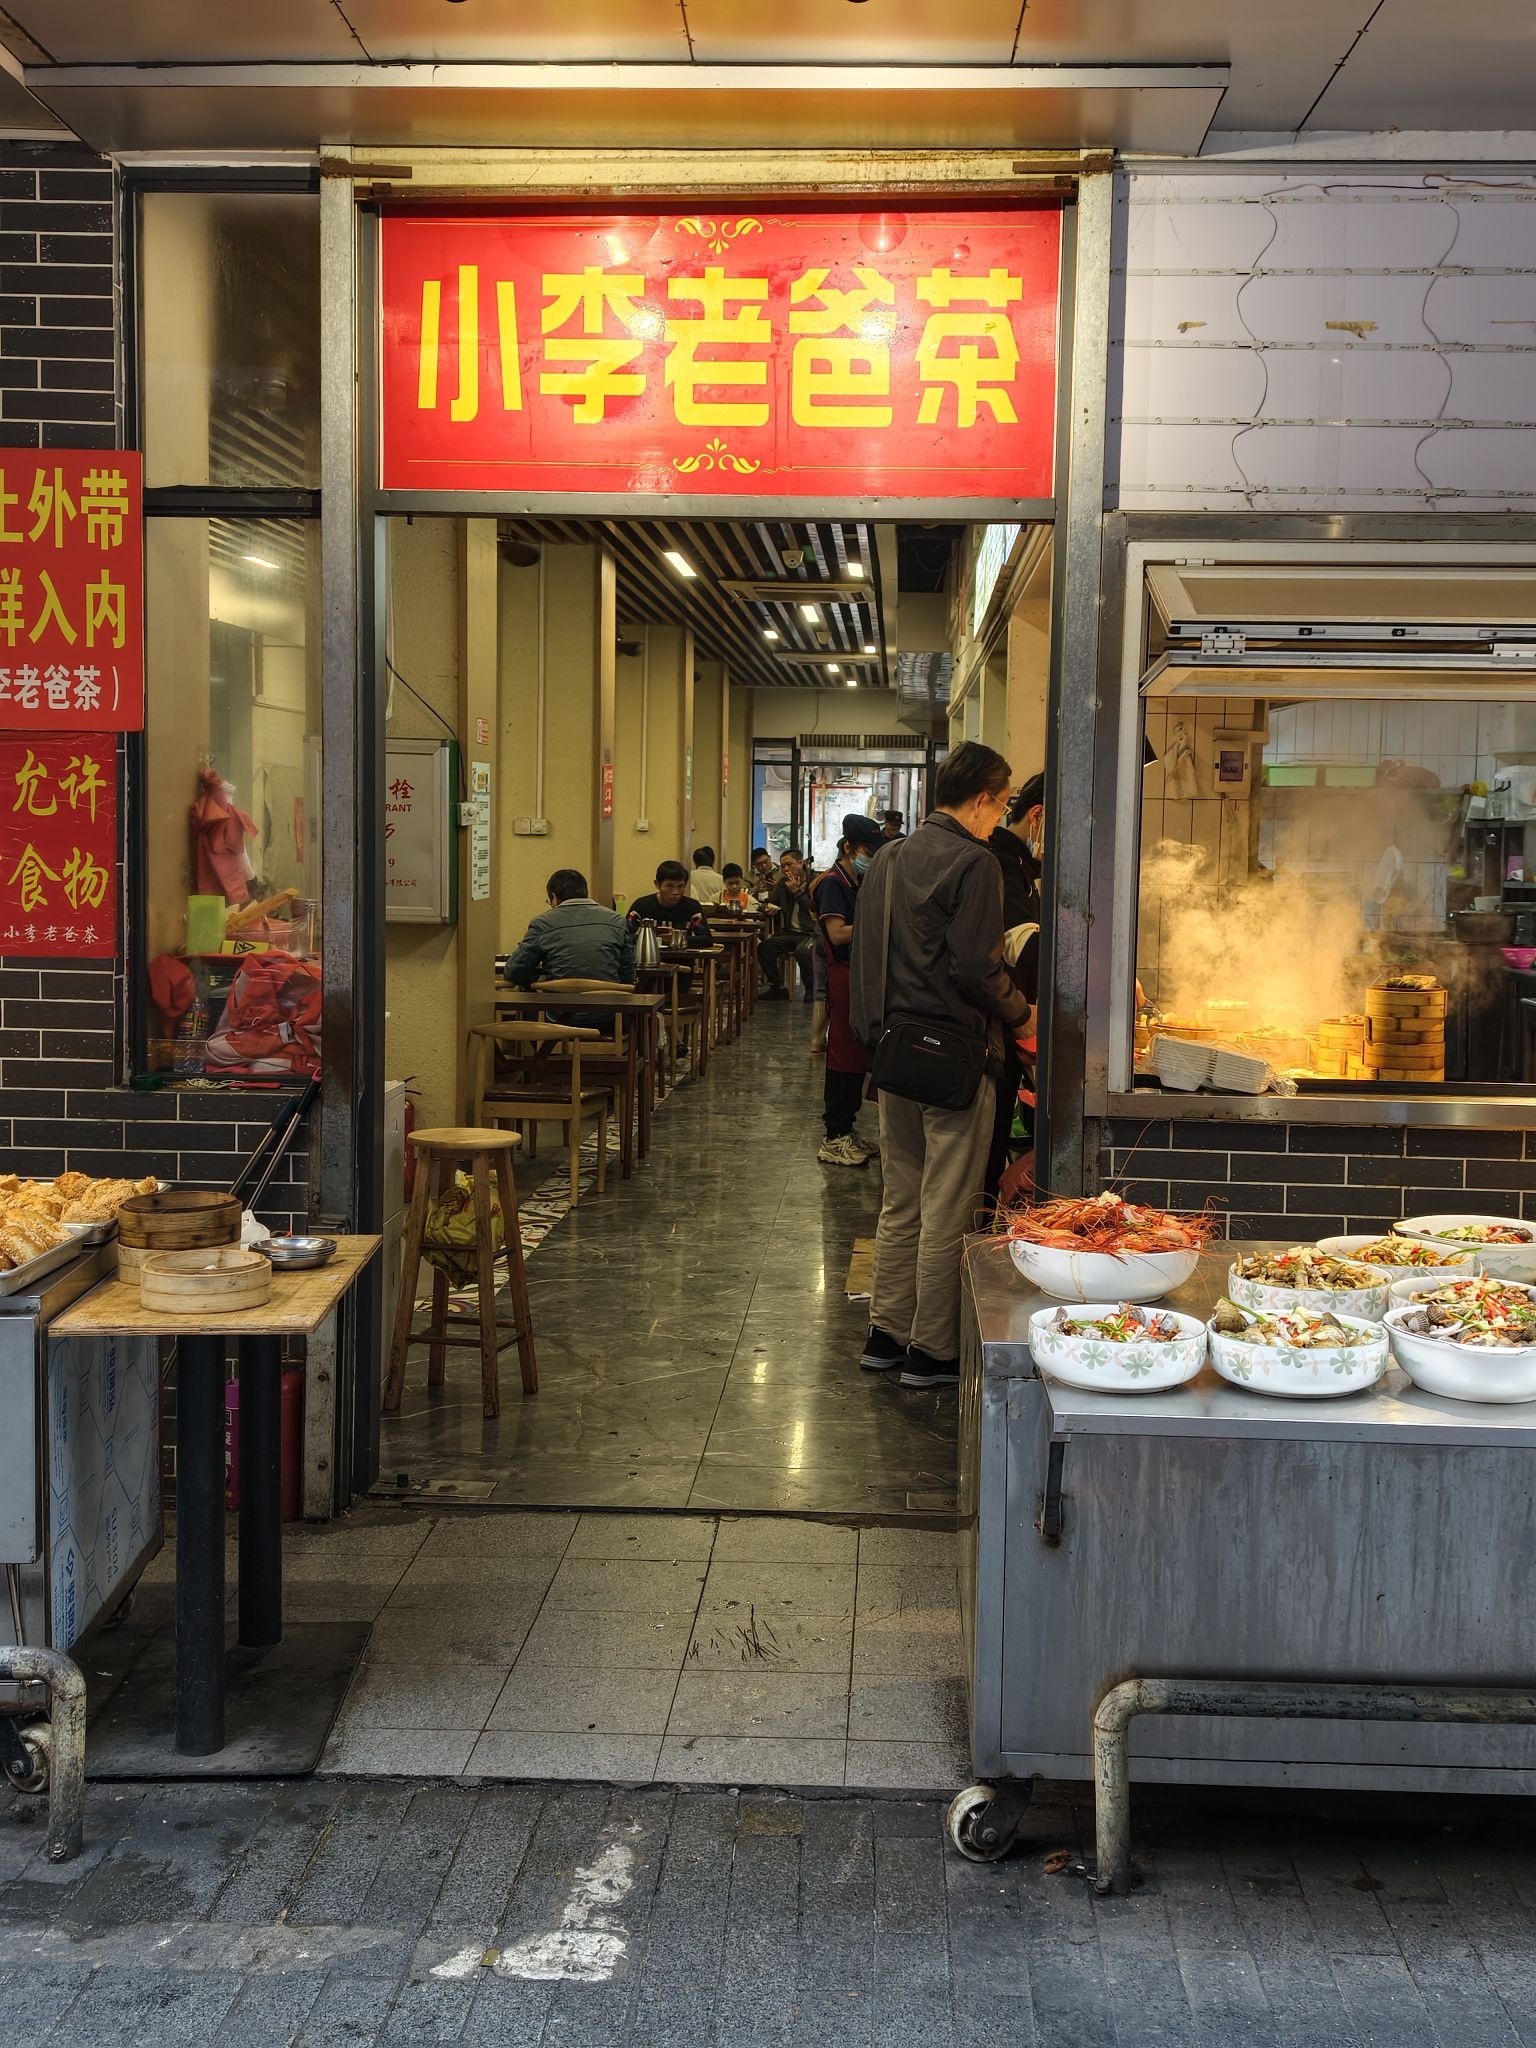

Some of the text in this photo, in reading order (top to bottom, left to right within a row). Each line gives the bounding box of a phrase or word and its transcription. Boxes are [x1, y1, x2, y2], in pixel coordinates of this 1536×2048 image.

[417, 264, 1023, 428] 小李老爸茶
[12, 748, 107, 824] 允许
[388, 778, 415, 800] 栓
[7, 842, 109, 913] 食物
[3, 923, 99, 945] 小李老爸茶
